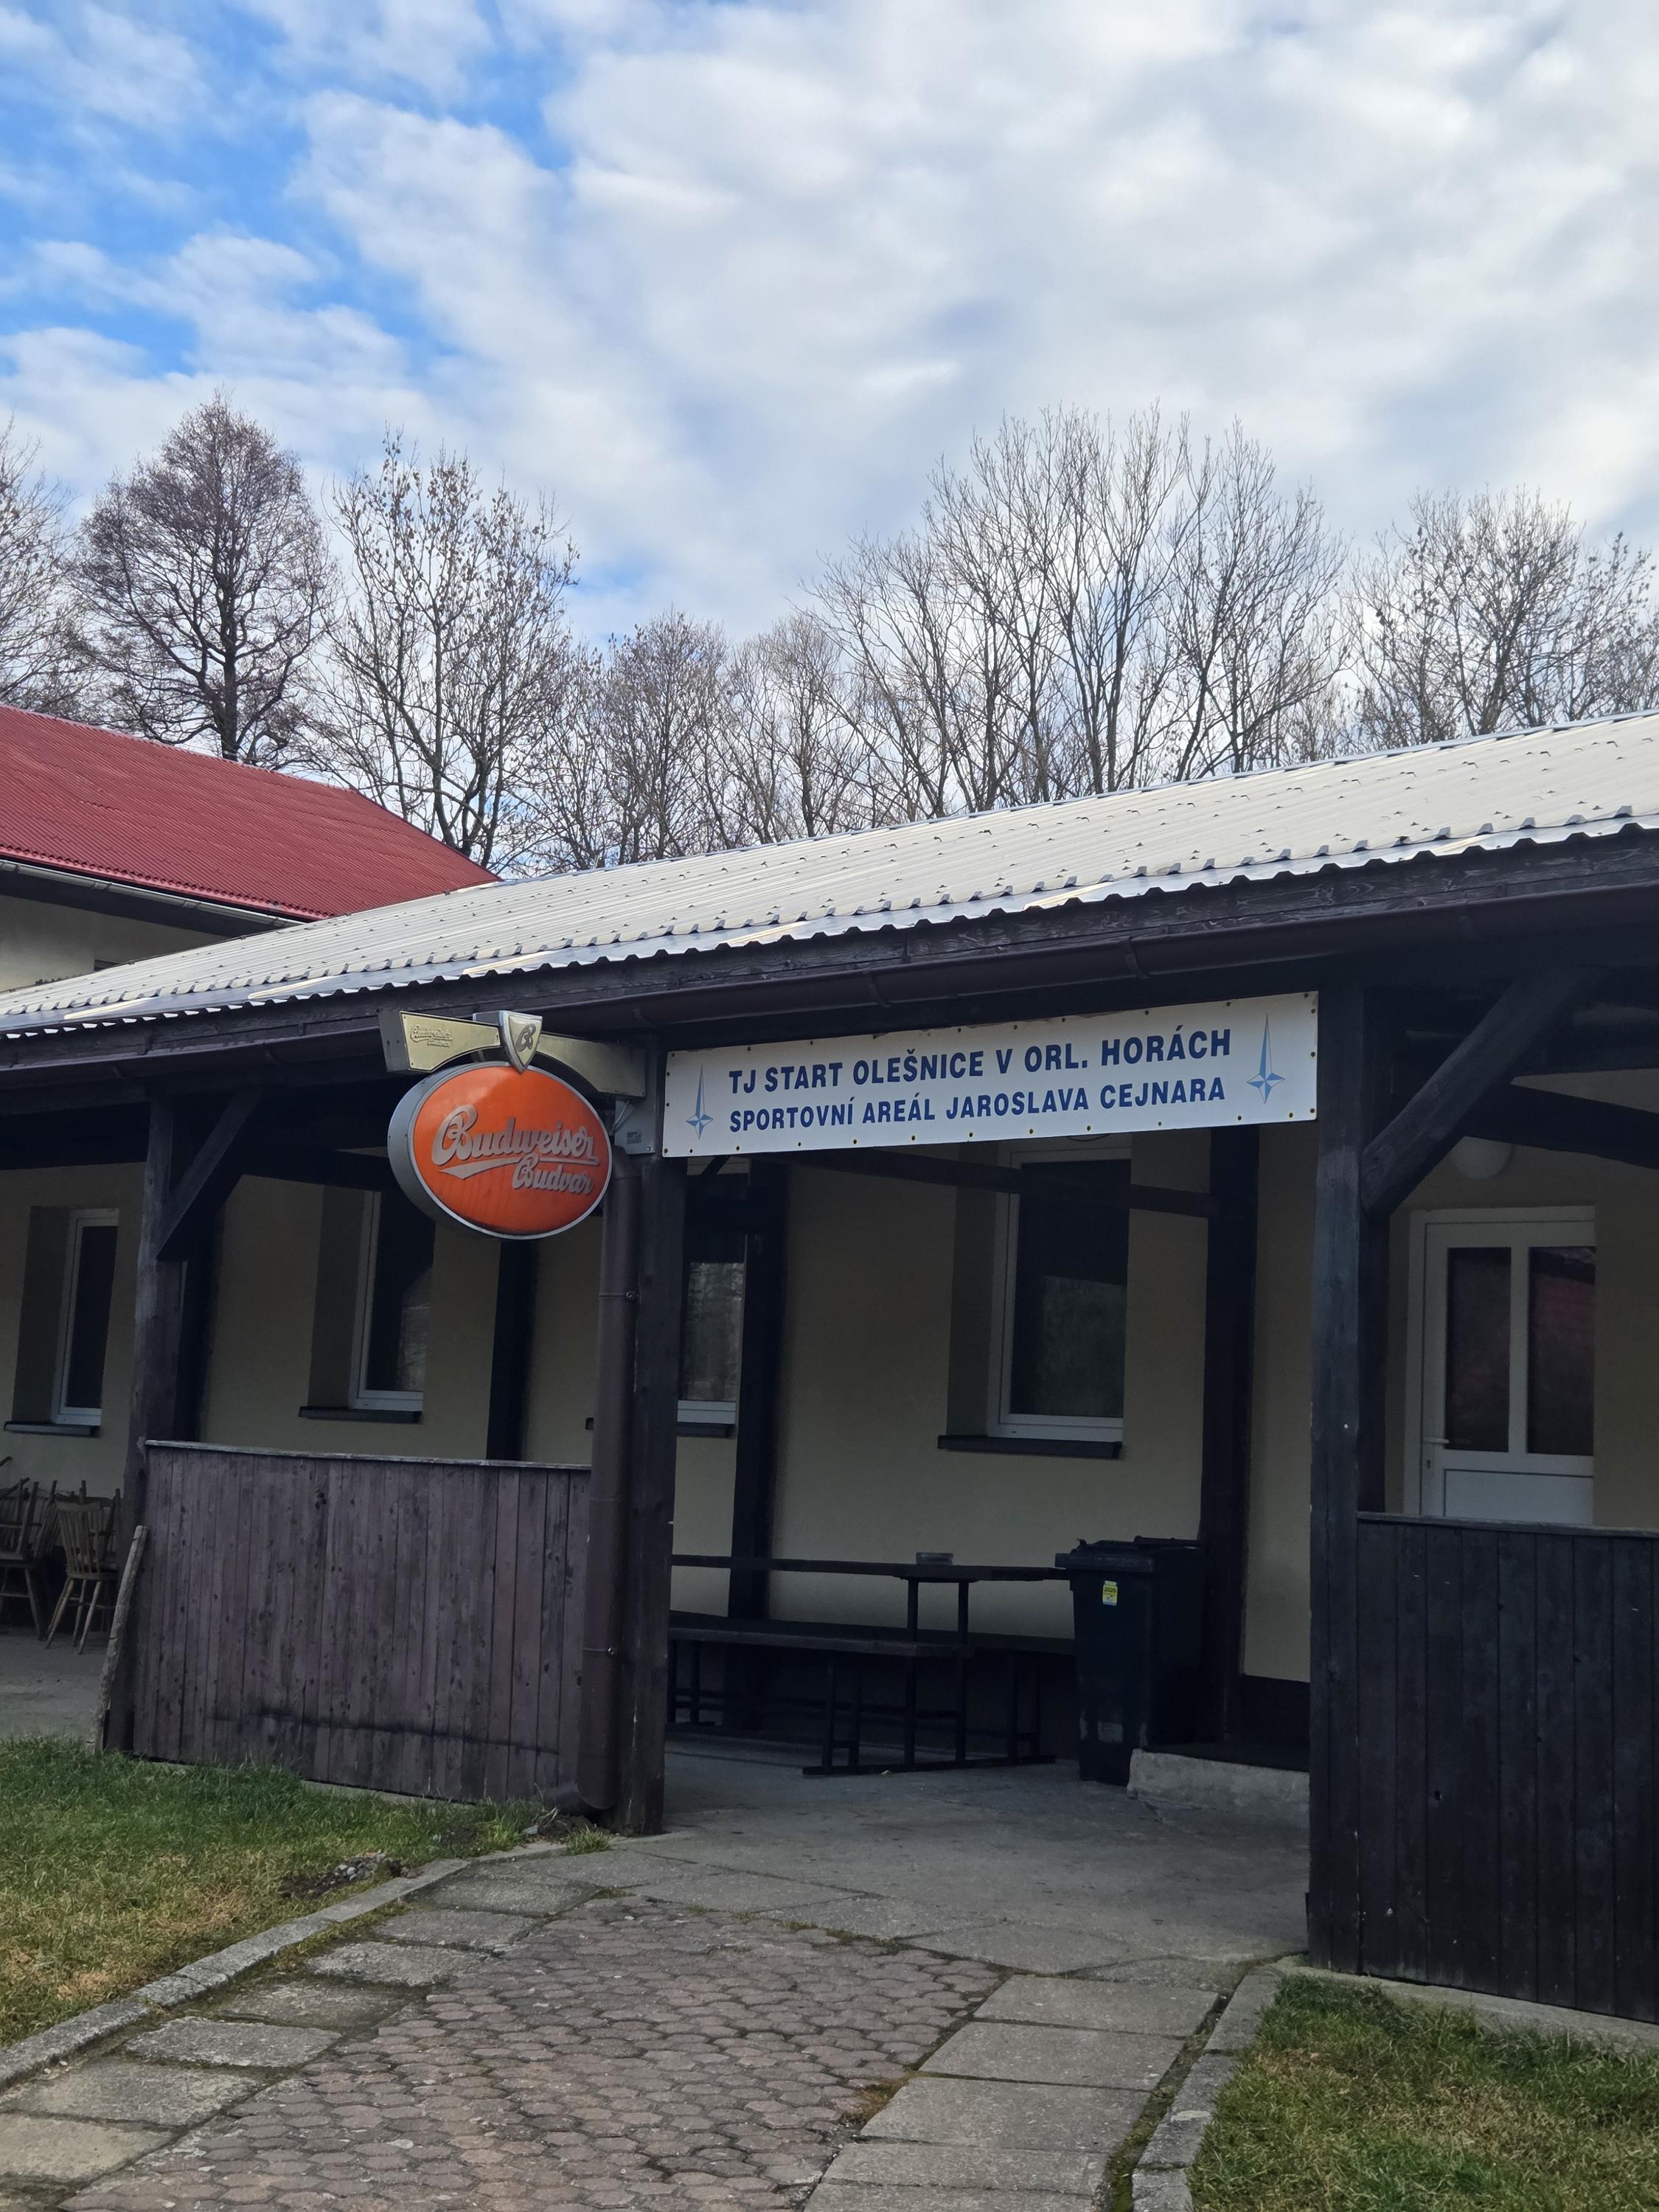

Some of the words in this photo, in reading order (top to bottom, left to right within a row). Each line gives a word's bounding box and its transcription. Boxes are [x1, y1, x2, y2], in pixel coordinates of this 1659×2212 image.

[728, 1069, 757, 1094] TJ
[765, 1062, 844, 1093] START
[852, 1048, 984, 1085] OLEŠNICE
[995, 1048, 1013, 1074] V
[1024, 1043, 1088, 1073] ORL.
[1101, 1024, 1231, 1066] HORÁCH
[730, 1096, 855, 1133] SPORTOVNÍ
[862, 1092, 936, 1124] AREÁL
[946, 1087, 1089, 1119] JAROSLAVA
[1100, 1077, 1225, 1109] CEJNARA
[431, 1105, 600, 1166] Budweiser
[512, 1153, 595, 1194] Budvar
